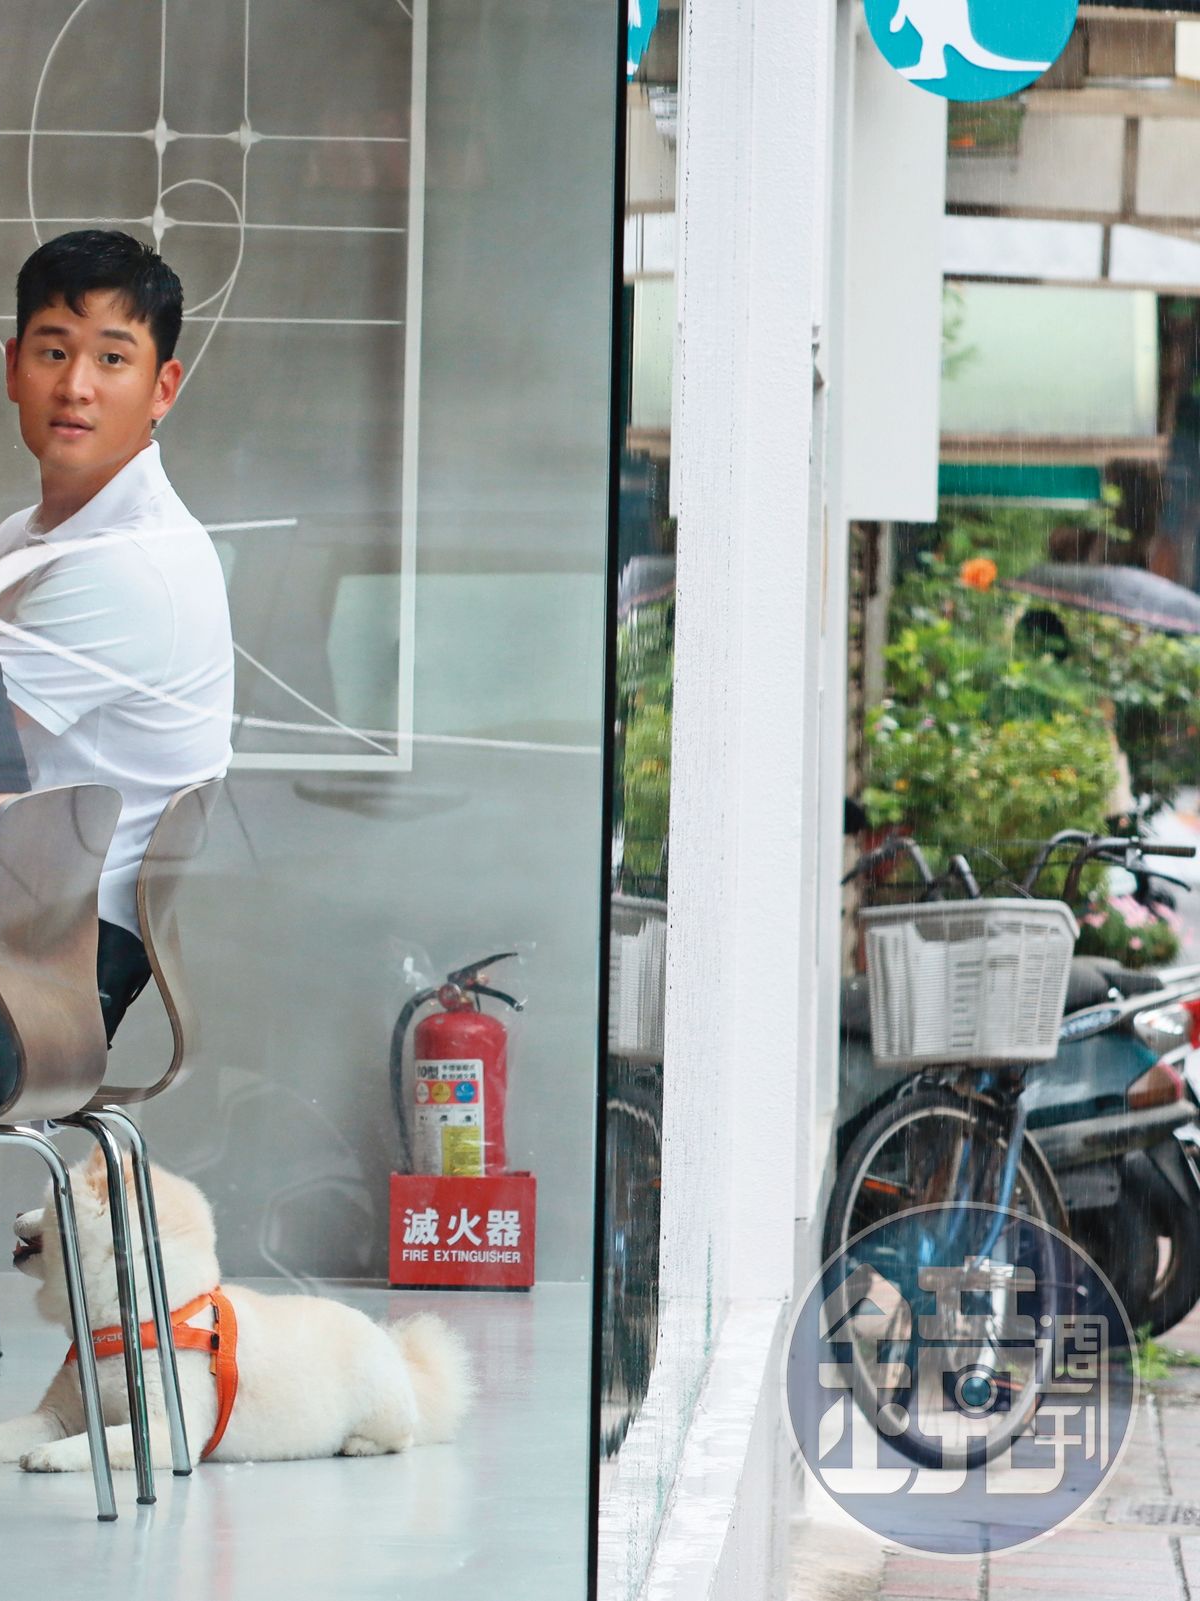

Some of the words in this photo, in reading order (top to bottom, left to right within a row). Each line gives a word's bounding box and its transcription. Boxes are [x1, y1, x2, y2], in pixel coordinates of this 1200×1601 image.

[402, 1207, 521, 1247] 滅火器
[402, 1250, 429, 1261] FIRE
[434, 1250, 521, 1263] EXTINGUISHER
